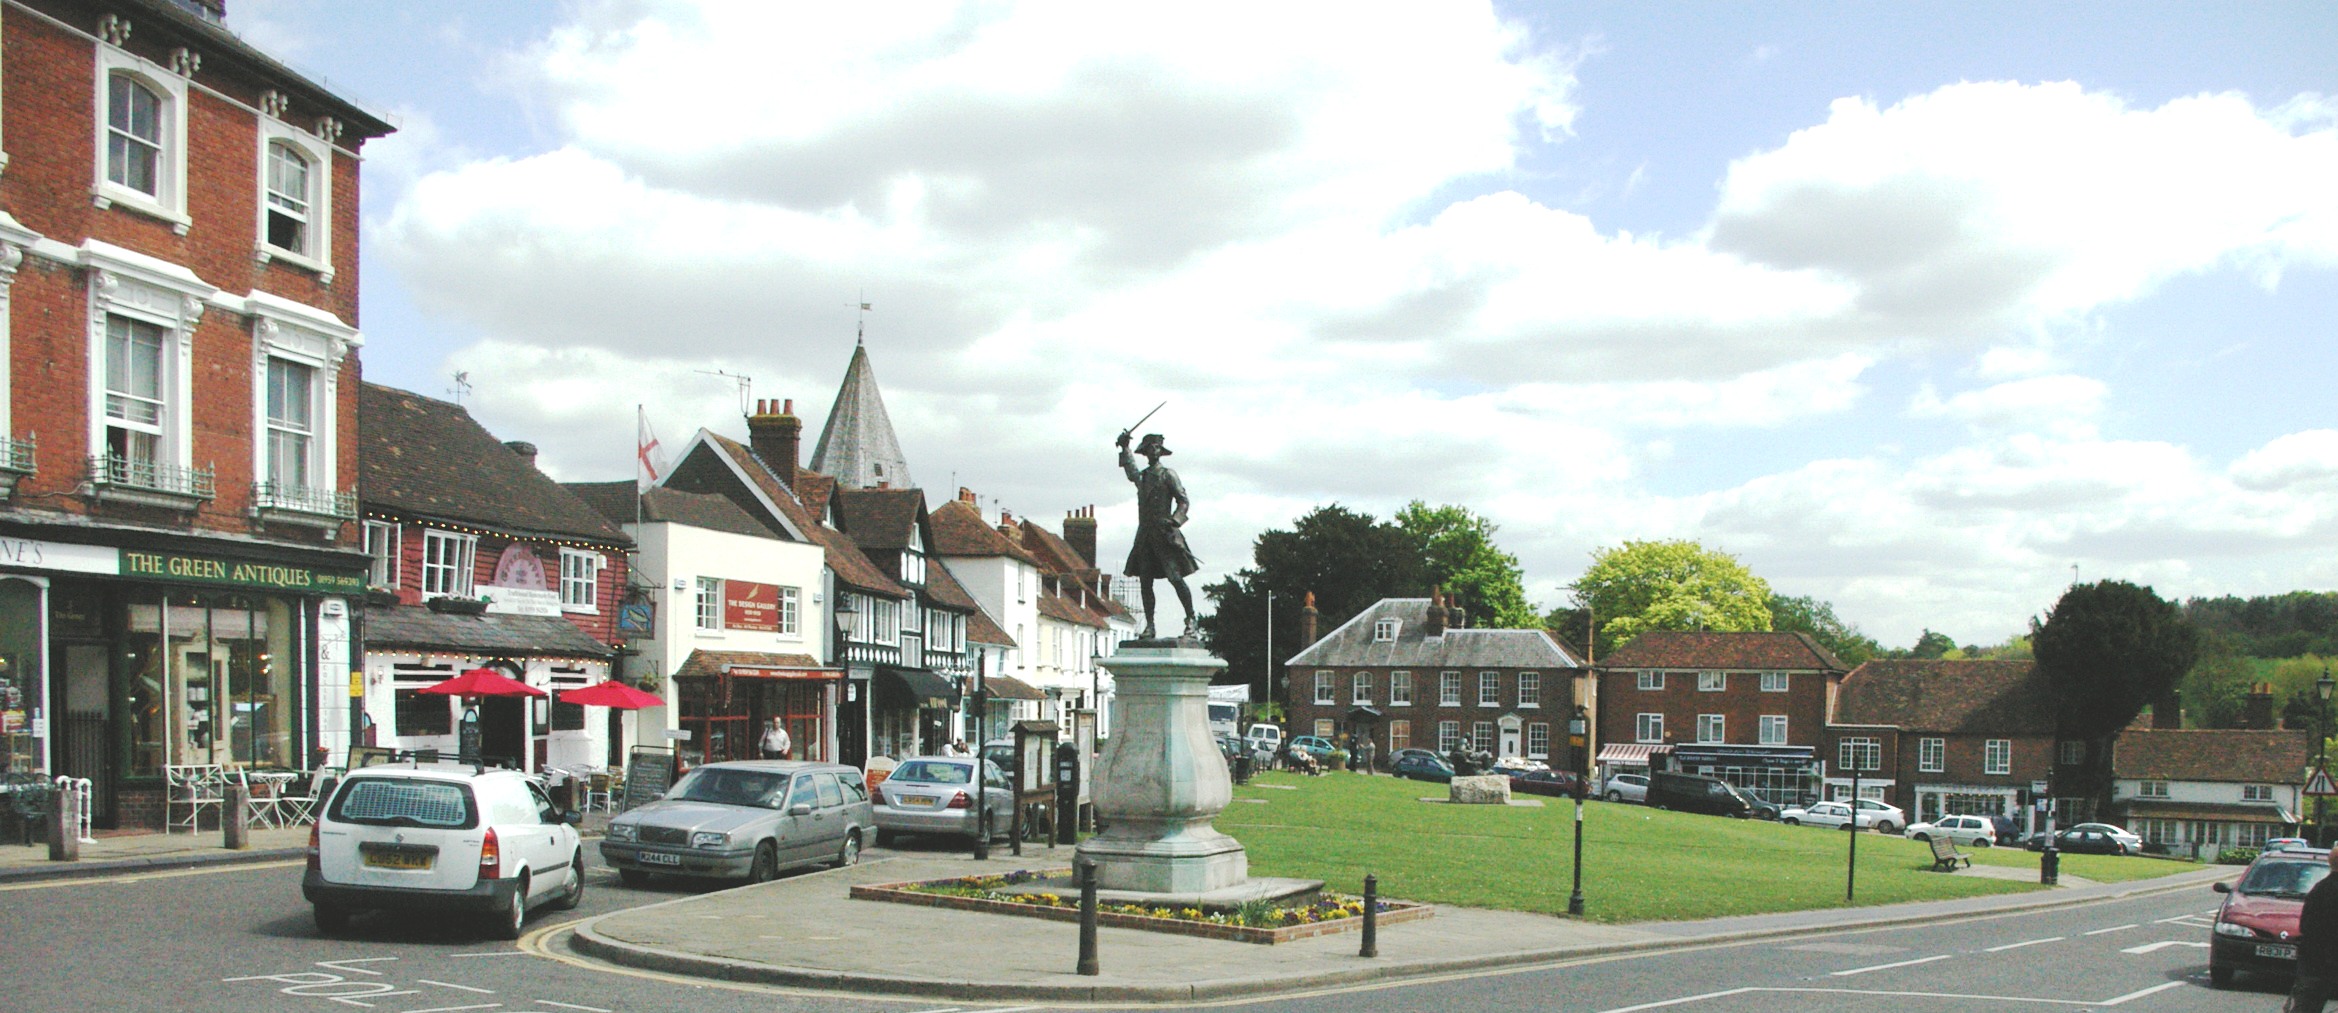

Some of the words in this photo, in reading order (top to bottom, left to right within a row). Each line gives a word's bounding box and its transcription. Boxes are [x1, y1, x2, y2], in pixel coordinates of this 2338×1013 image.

[127, 552, 164, 575] THE
[169, 556, 226, 579] GREEN
[233, 563, 311, 587] ANTIQUES
[728, 599, 738, 607] THE
[738, 600, 756, 609] DESIGN
[756, 602, 776, 610] GALLERY
[321, 644, 330, 661] &
